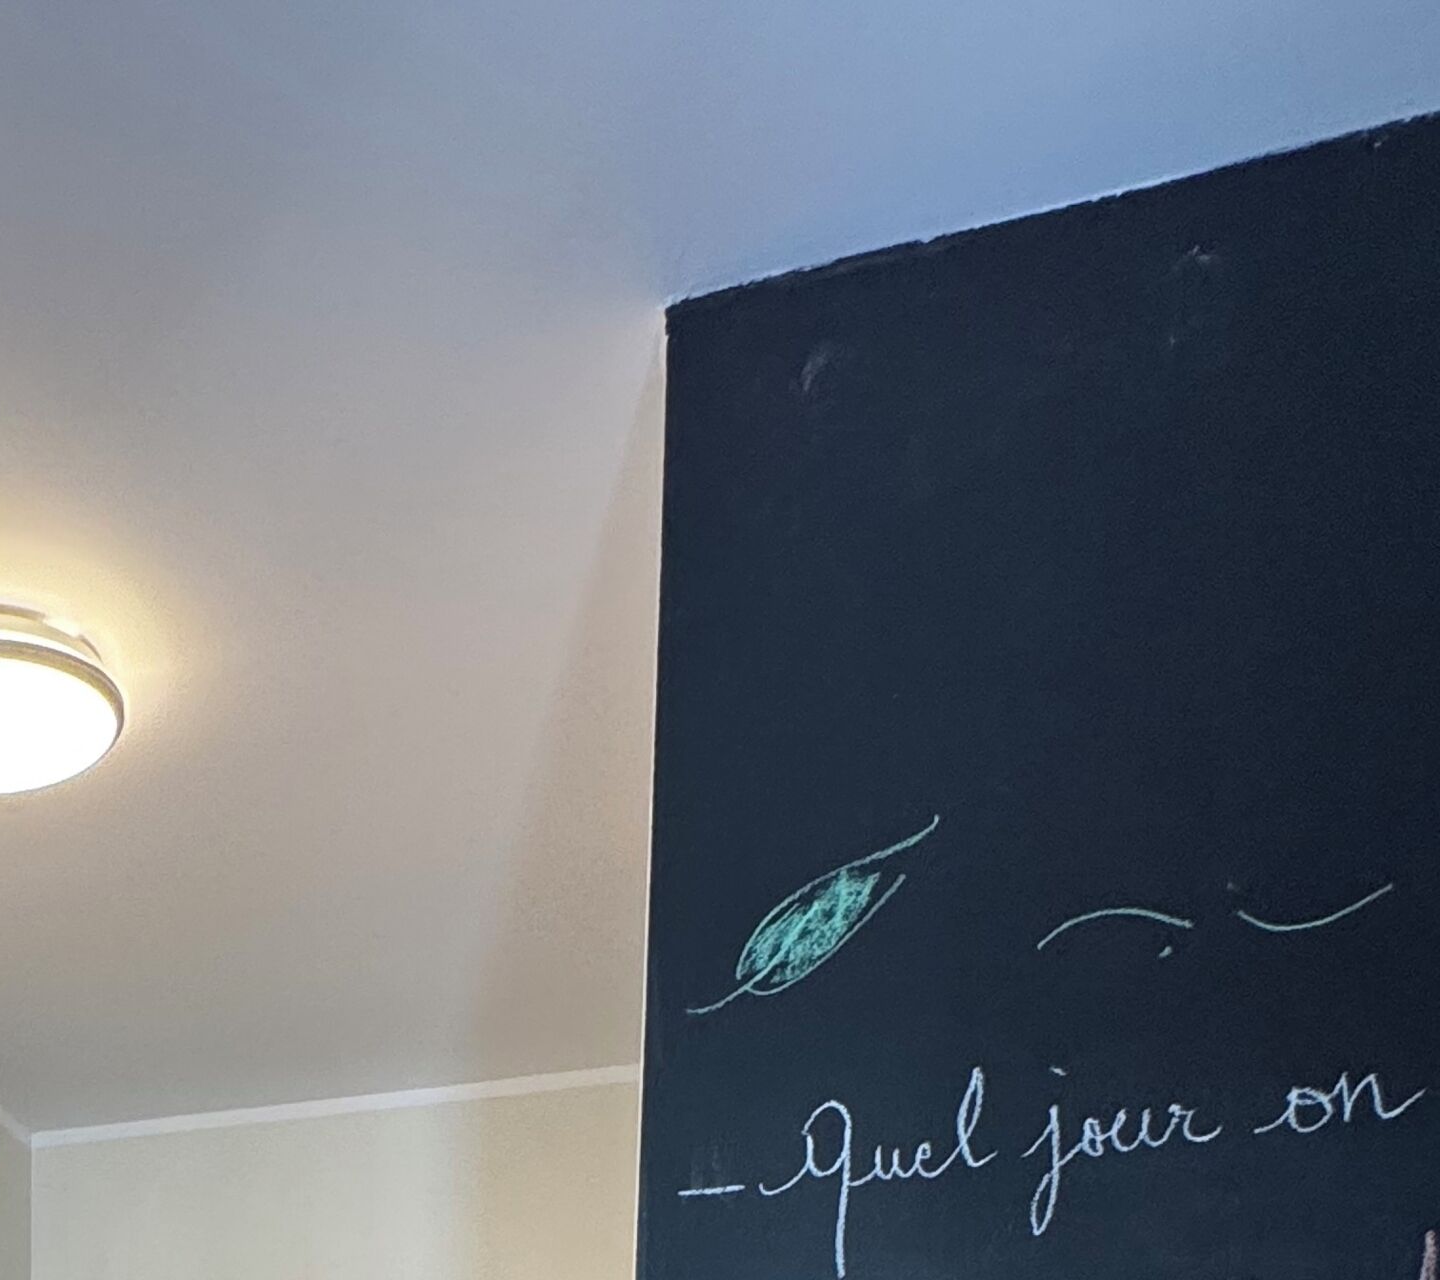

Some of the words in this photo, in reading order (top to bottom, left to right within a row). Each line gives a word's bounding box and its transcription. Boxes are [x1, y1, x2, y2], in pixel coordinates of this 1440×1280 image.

[760, 1066, 995, 1279] Quel
[1024, 1066, 1221, 1236] jour
[1255, 1073, 1426, 1134] on
